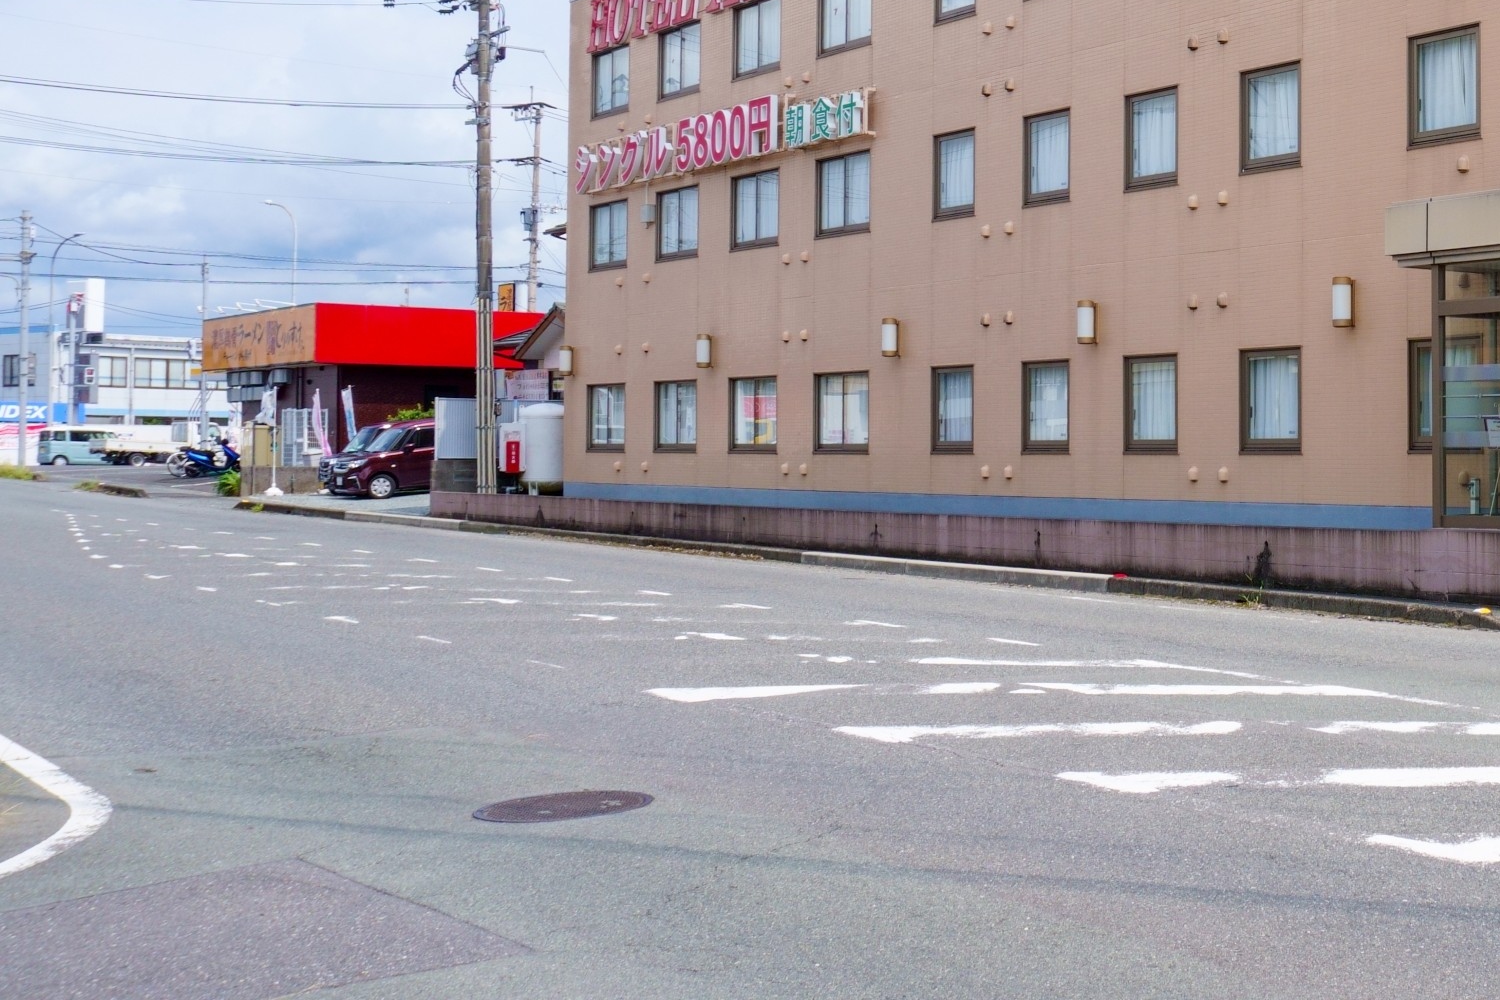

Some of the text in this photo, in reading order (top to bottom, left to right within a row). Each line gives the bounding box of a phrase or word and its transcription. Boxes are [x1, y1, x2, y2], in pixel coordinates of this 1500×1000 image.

[575, 91, 864, 194] シングル 5800円 朝食付
